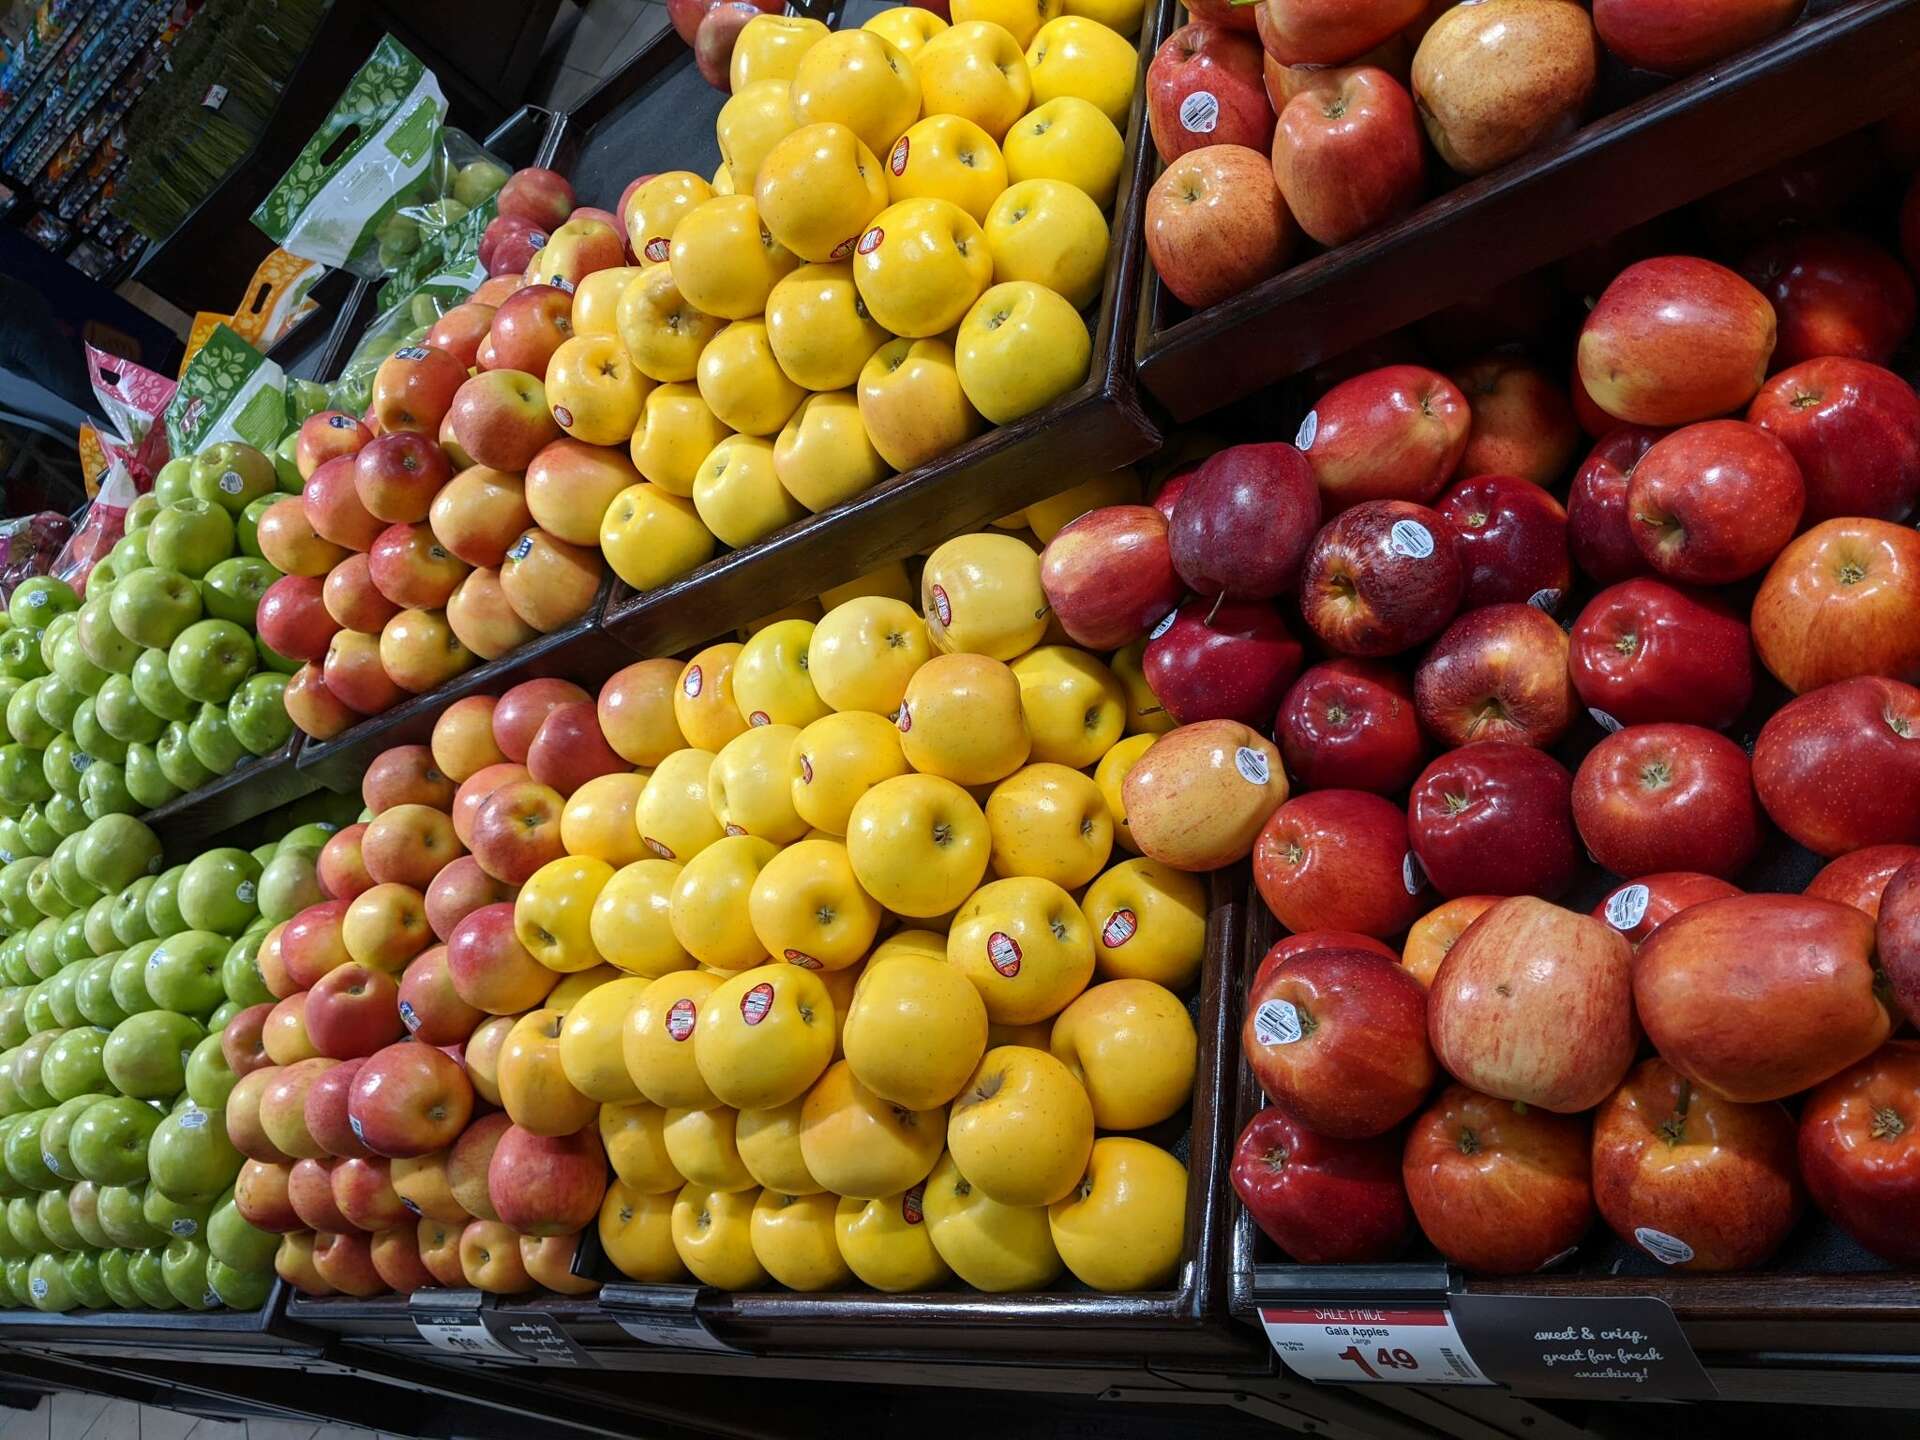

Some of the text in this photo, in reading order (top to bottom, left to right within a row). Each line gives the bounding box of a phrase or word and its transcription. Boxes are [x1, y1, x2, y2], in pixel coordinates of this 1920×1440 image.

[1325, 1326, 1390, 1338] Gala Apples
[1534, 1326, 1579, 1341] sweet
[1581, 1327, 1596, 1340] &
[1543, 1347, 1664, 1367] great for fresh
[1574, 1368, 1648, 1383] snacking!
